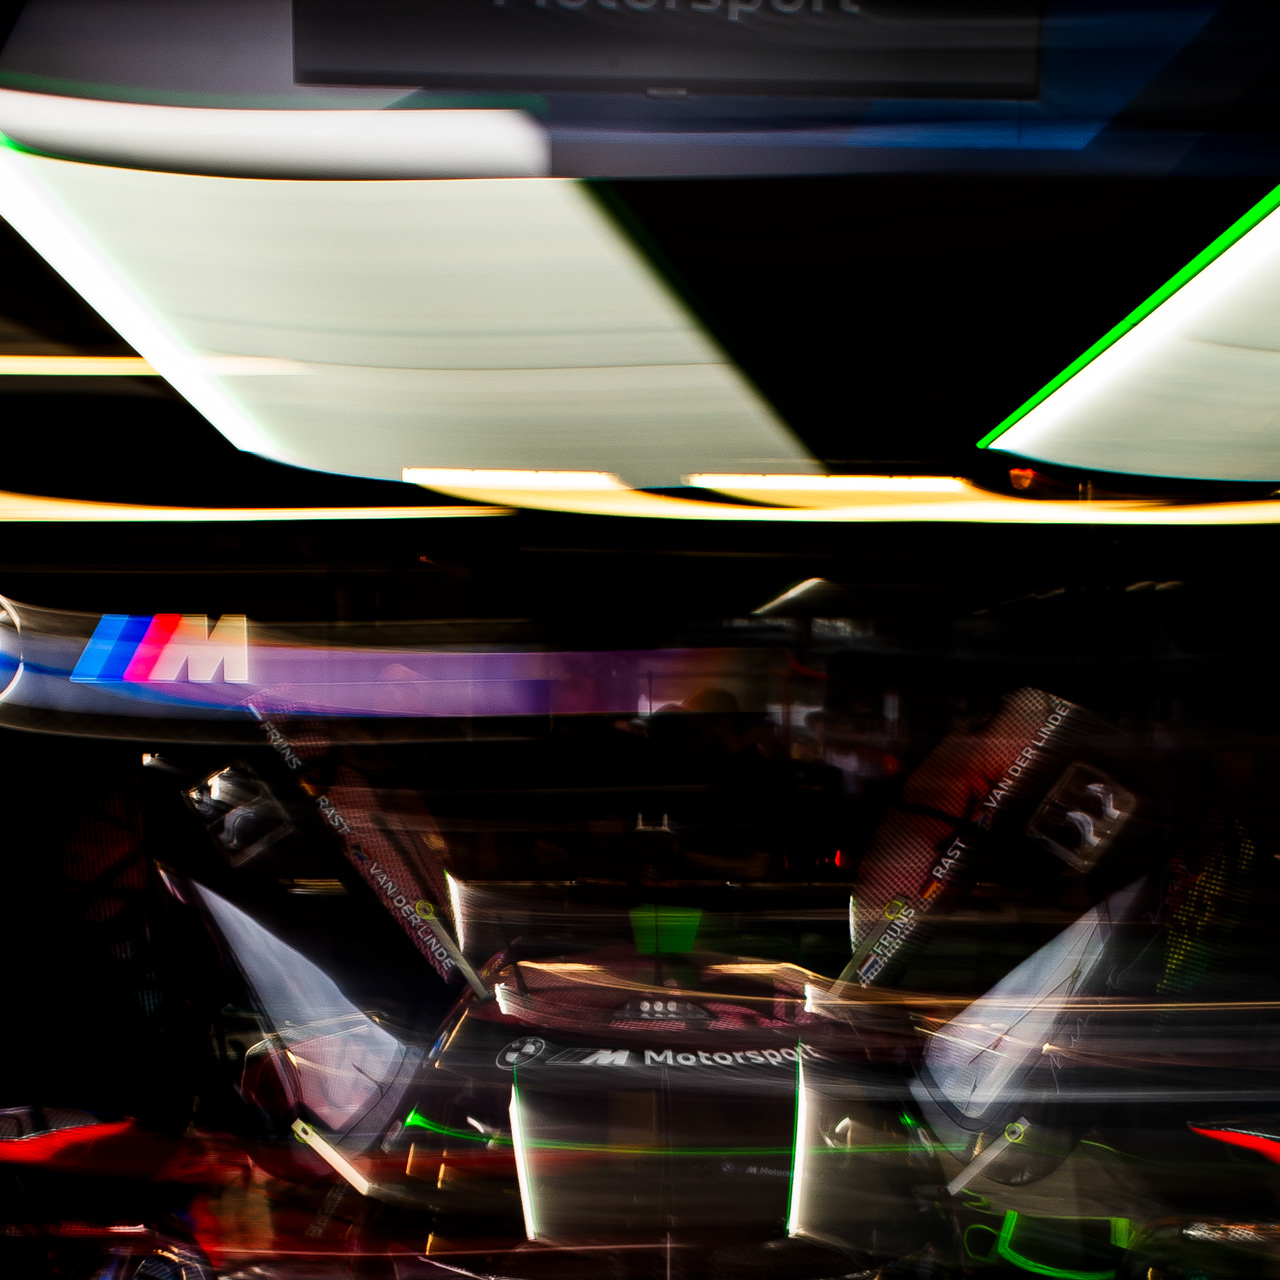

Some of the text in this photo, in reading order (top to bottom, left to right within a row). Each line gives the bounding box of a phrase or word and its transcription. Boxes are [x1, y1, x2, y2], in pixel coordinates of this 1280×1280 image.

[983, 701, 1070, 809] VAN DER LINDE
[315, 795, 352, 836] RAST
[932, 837, 967, 880] RAST
[370, 862, 455, 971] VAN DER LINDE
[644, 1042, 820, 1067] Motorsport
